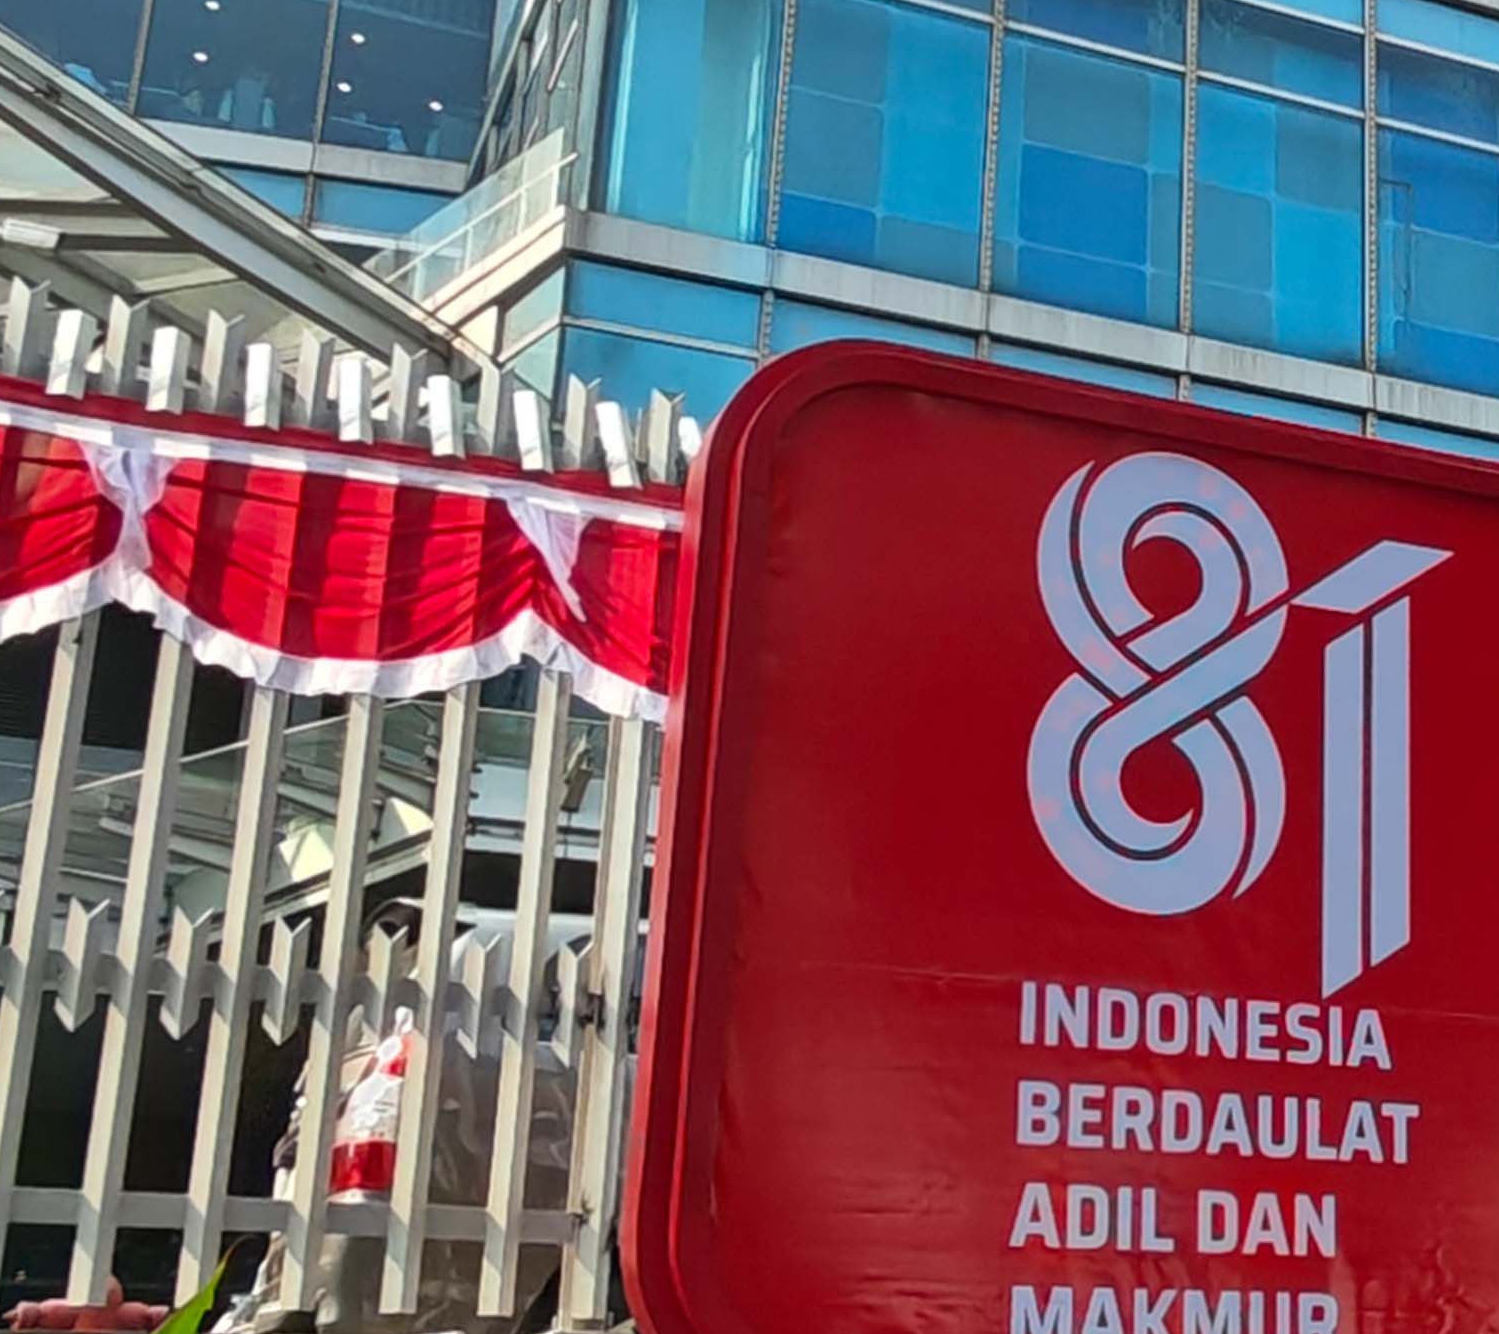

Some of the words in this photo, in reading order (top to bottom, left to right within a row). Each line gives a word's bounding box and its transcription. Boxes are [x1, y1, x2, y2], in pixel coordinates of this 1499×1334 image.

[1026, 451, 1454, 999] 81
[1020, 980, 1392, 1071] INDONESIA
[1015, 1079, 1421, 1165] BERDAULAT
[1008, 1181, 1175, 1253] ADIL
[1196, 1188, 1337, 1259] DAN
